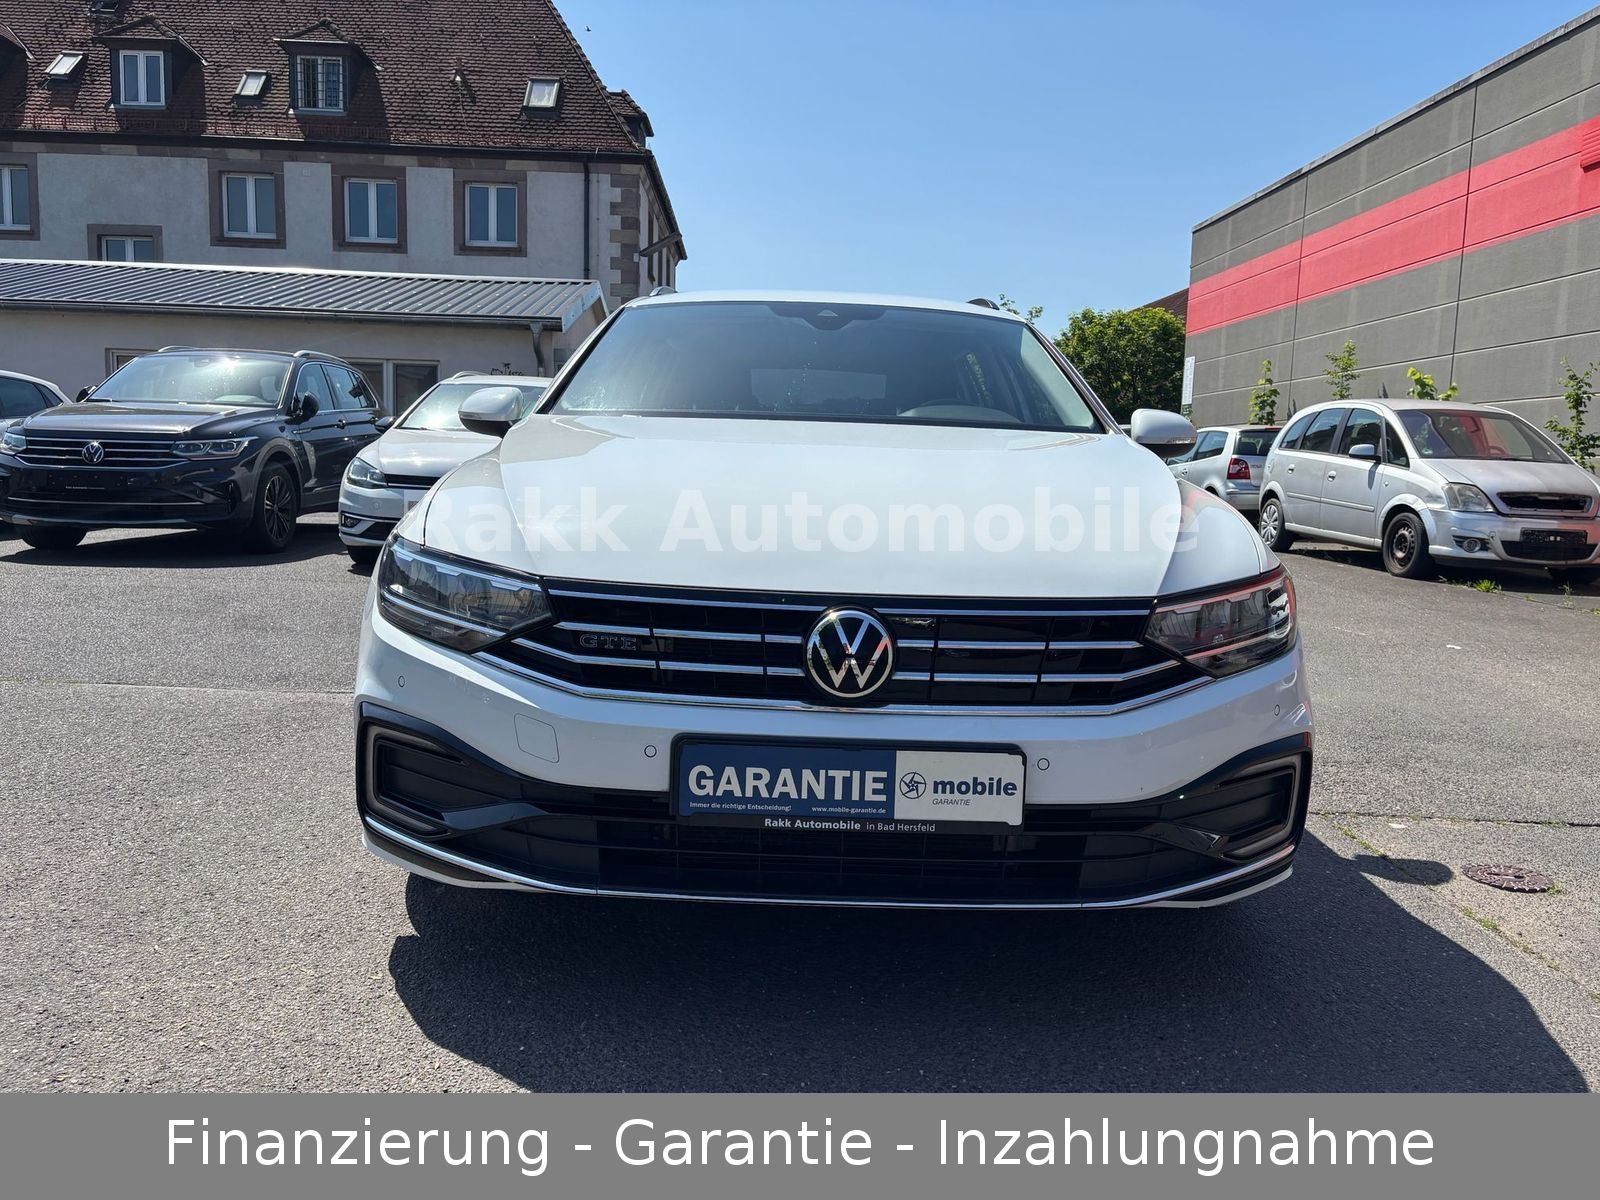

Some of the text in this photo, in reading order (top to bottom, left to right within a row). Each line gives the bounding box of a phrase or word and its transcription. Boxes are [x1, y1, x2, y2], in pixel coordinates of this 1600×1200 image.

[580, 633, 636, 651] GTE
[688, 765, 887, 802] GARANTIE
[932, 777, 1017, 796] mobile
[747, 803, 792, 812] Entscheidung!
[811, 806, 886, 814] www.mobile-garantie.de
[764, 818, 861, 830] Rakk Automobile
[866, 822, 936, 832] in Bad Hersfeld
